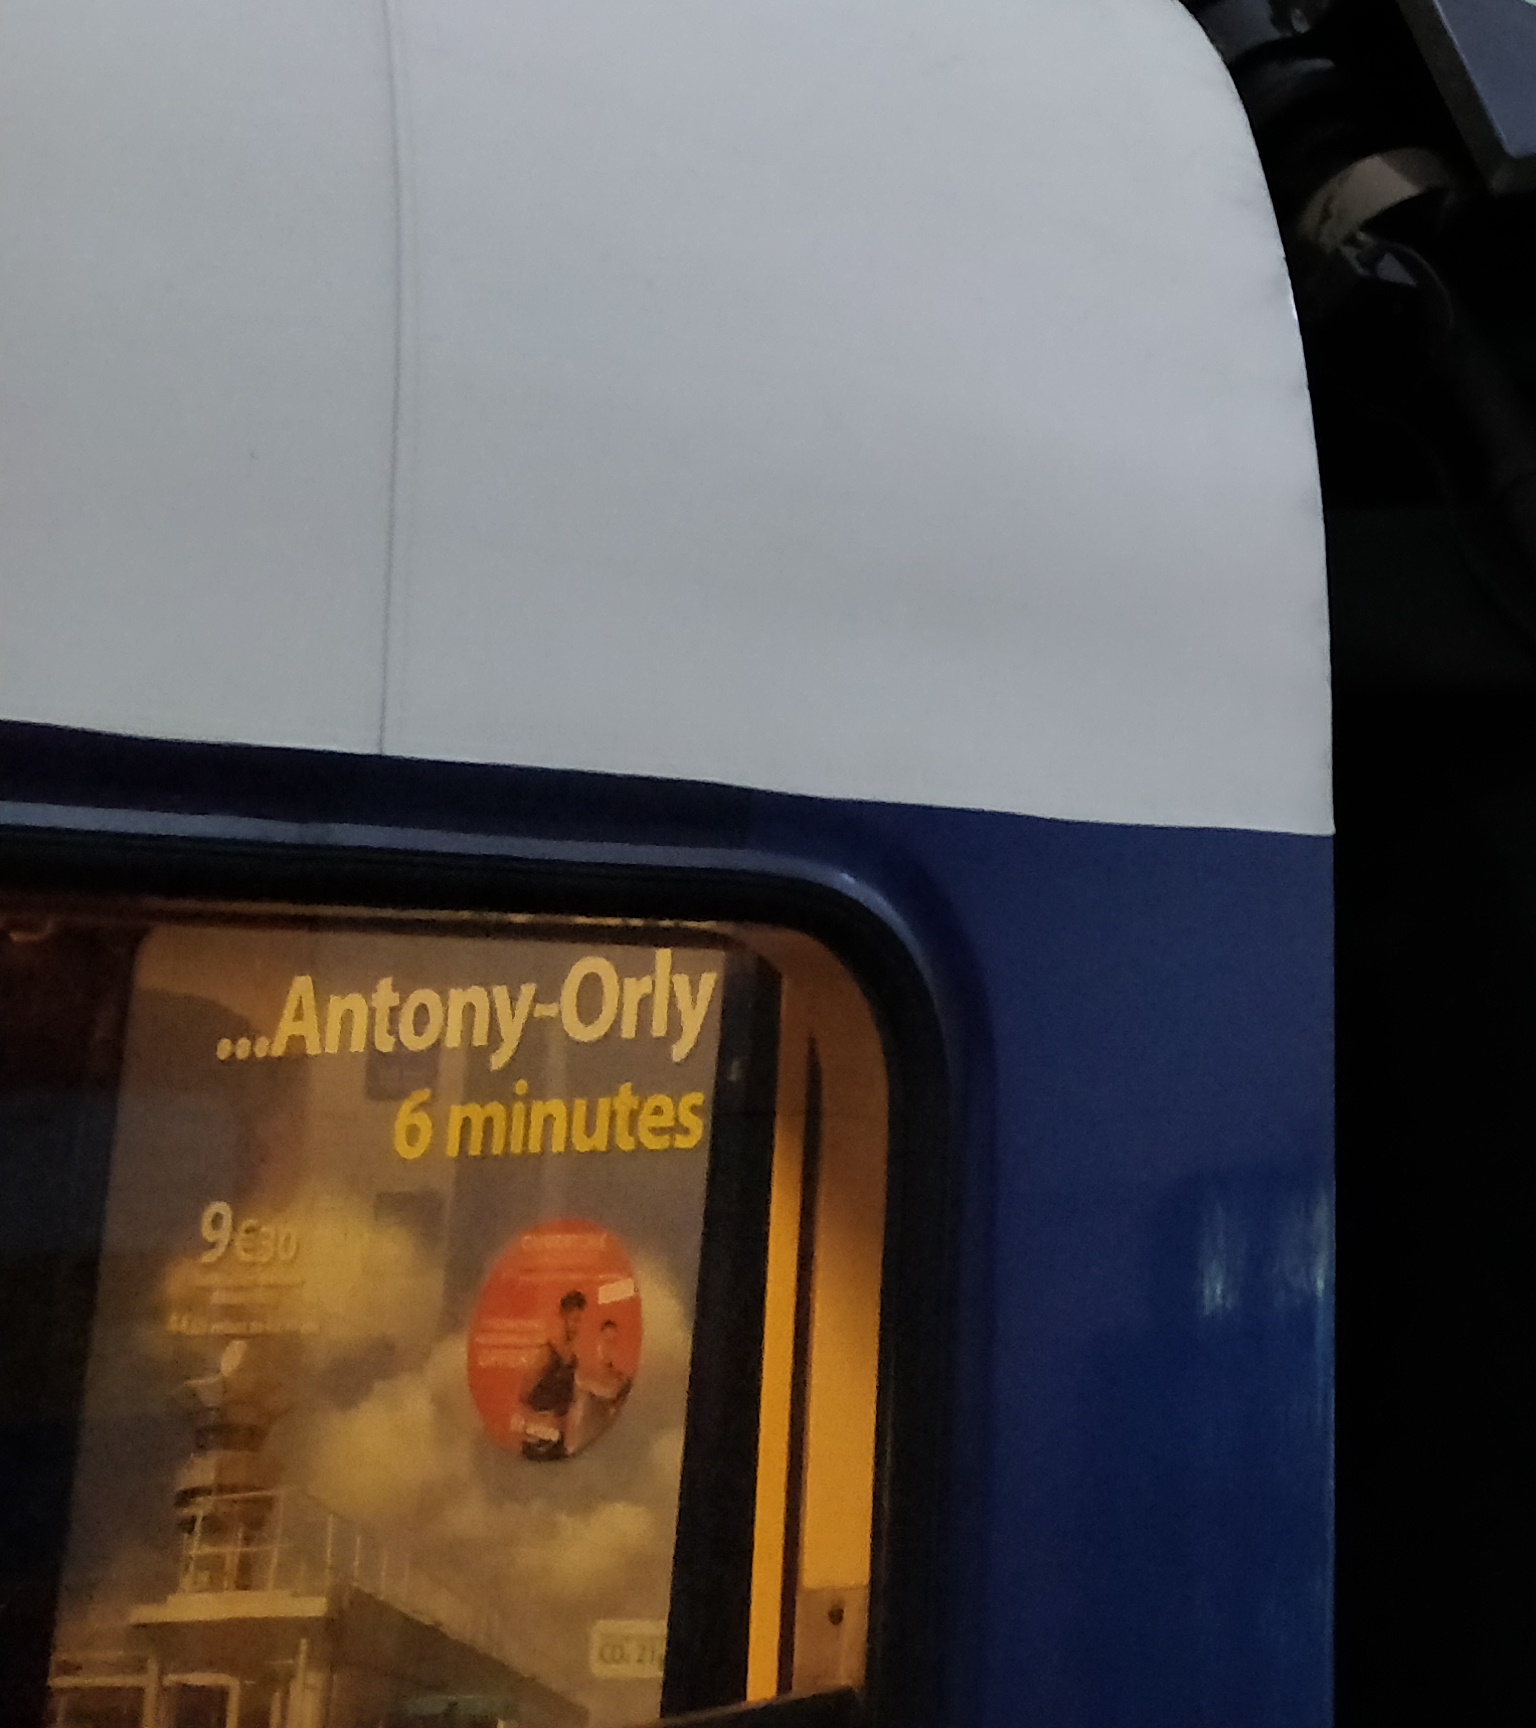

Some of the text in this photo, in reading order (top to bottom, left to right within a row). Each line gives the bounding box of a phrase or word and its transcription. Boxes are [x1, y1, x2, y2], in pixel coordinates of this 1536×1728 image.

[216, 947, 718, 1071] ...Antony-Orly
[394, 1078, 706, 1160] 6 minutes
